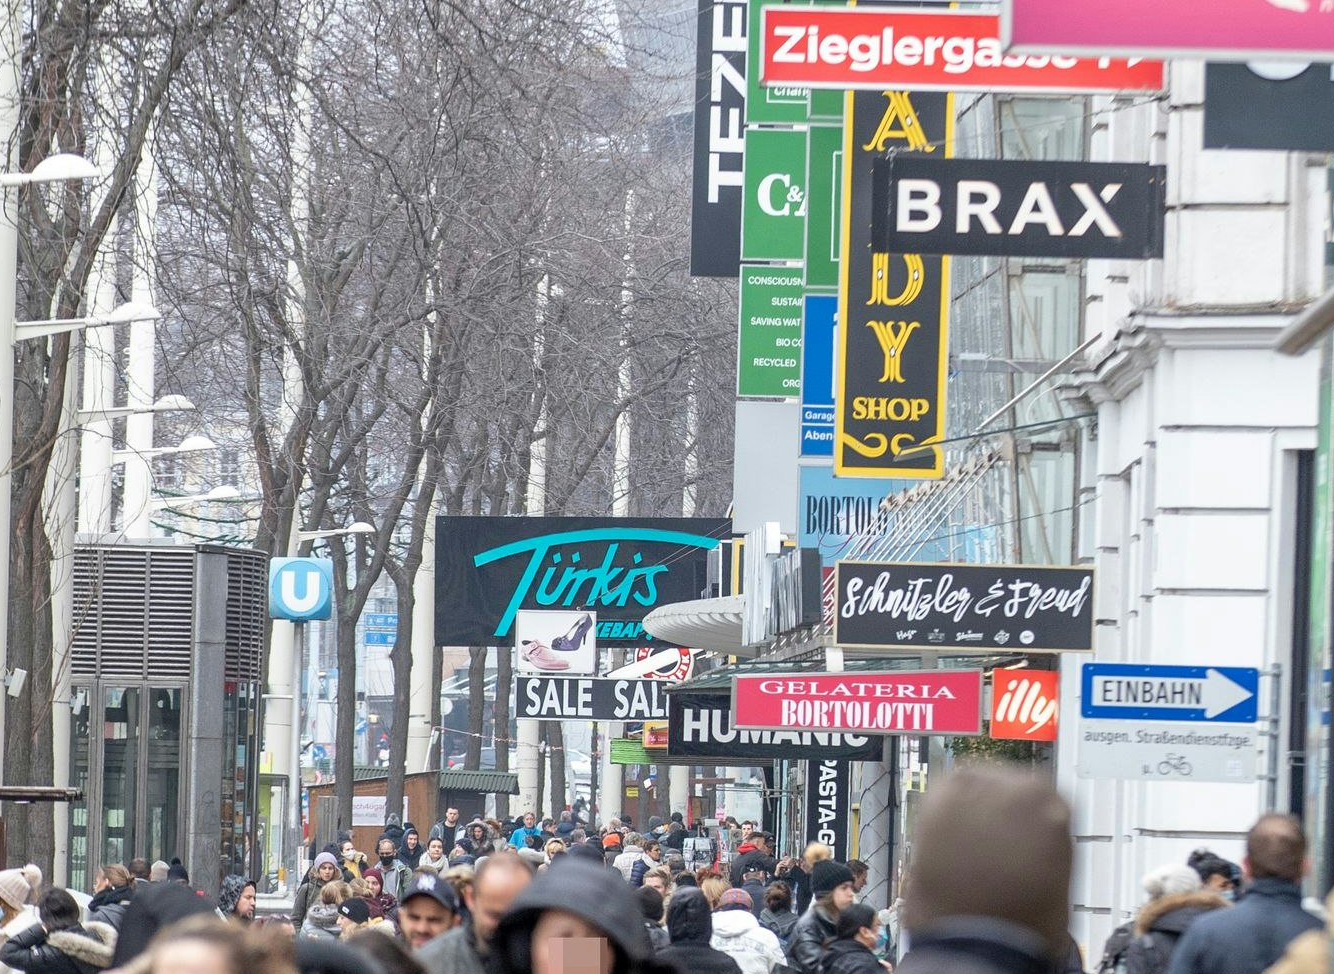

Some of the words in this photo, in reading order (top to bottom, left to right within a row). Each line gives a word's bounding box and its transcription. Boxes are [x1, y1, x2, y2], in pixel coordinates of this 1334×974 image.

[708, 0, 747, 203] TEZE
[896, 178, 1123, 238] BRAX
[751, 317, 782, 326] SAVING
[776, 338, 790, 347] BIO
[754, 358, 796, 368] RECYCLED
[852, 397, 930, 421] SHOP
[805, 430, 835, 440] Aben
[282, 571, 320, 612] U
[474, 527, 721, 637] Türkis
[841, 571, 972, 623] Schnitzler
[975, 578, 1007, 617] &
[1007, 575, 1092, 619] Freud
[525, 678, 593, 717] SALE
[759, 679, 956, 700] GELATERIA
[1102, 679, 1203, 705] EINBAHN
[781, 699, 934, 730] BORTOLOTTI
[996, 679, 1057, 735] illy
[1084, 730, 1133, 744] ausgen.
